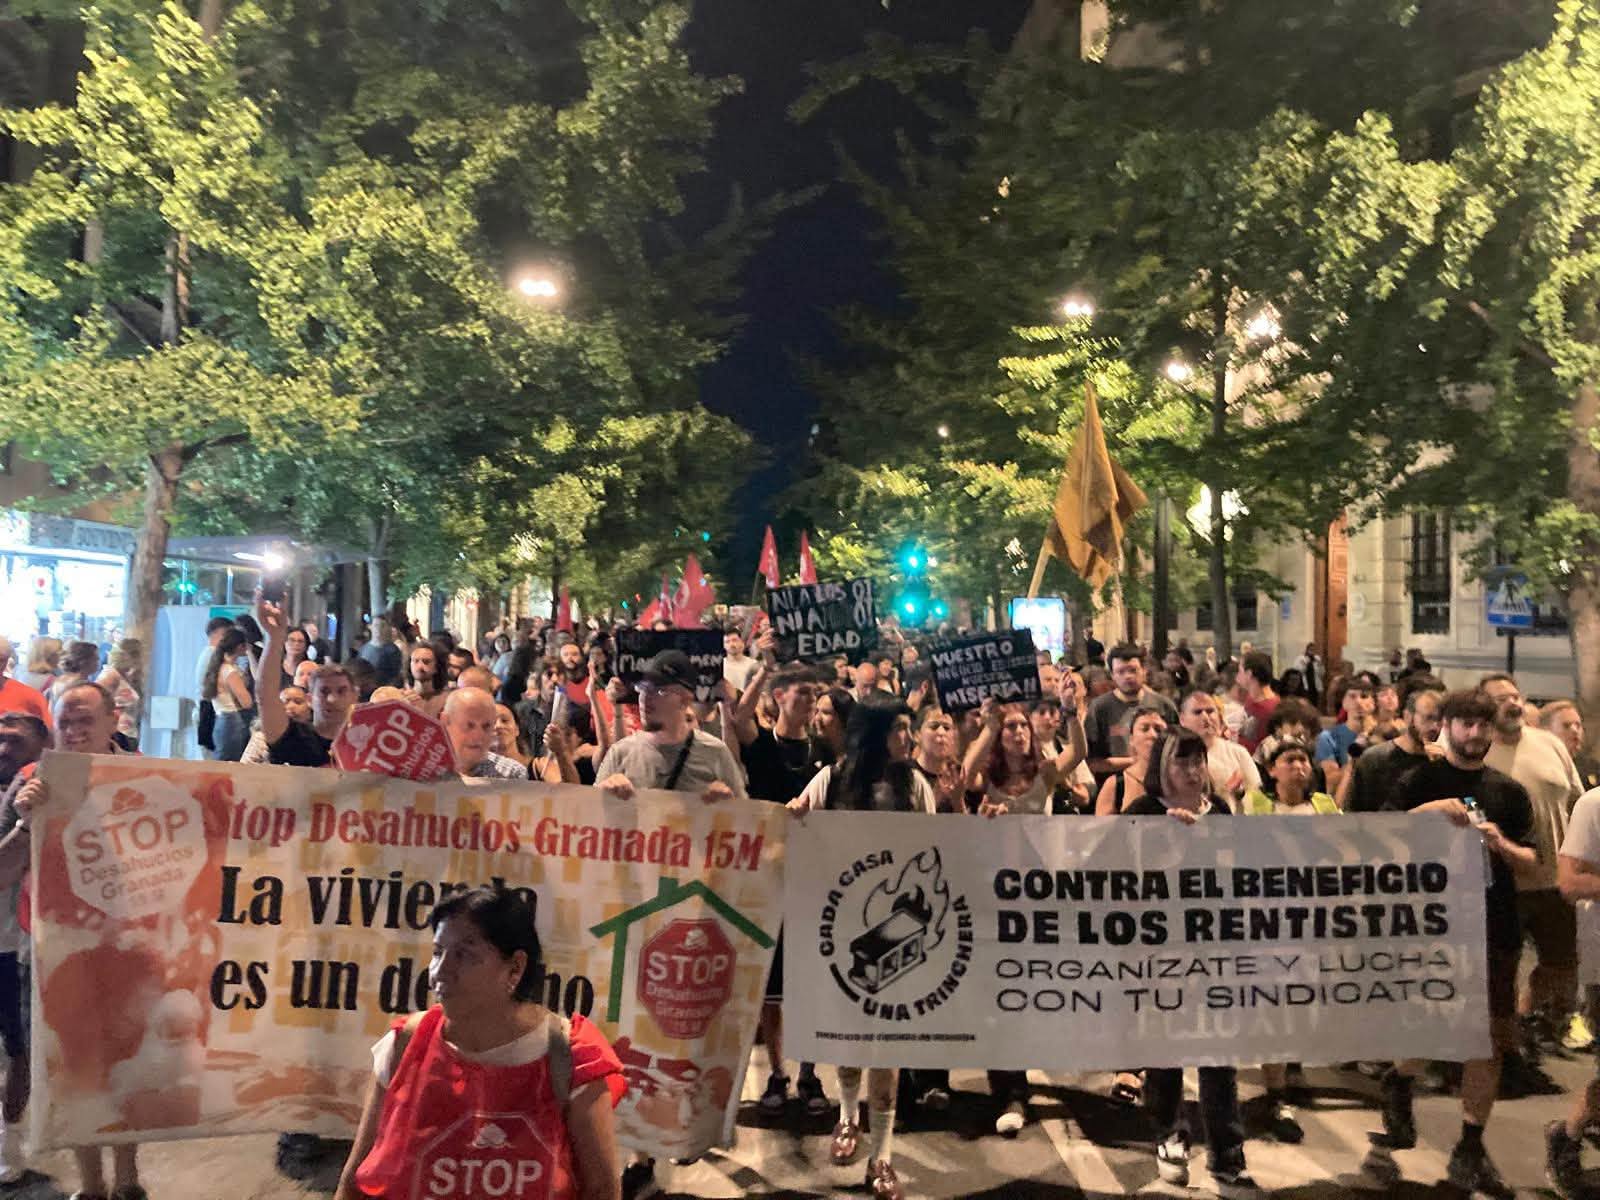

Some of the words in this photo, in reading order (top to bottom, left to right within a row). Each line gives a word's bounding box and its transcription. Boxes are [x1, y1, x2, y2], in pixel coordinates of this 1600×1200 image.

[798, 630, 861, 656] EDAD
[931, 641, 1014, 667] VUESTRO
[364, 709, 415, 771] TOP
[75, 808, 190, 865] STOP
[201, 777, 296, 848] Stop
[308, 803, 521, 854] Desahucios
[534, 816, 693, 868] Granada
[703, 830, 765, 872] 15M
[79, 847, 194, 886] Desahucios
[101, 867, 184, 901] Granada
[993, 868, 1170, 901] CONTRA
[1178, 868, 1224, 899] EL
[1231, 861, 1449, 898] BENEFICIO
[216, 866, 285, 926] La
[818, 889, 845, 958] CADA
[838, 850, 895, 888] CASA
[997, 910, 1060, 945] DE
[1077, 910, 1169, 946] LOS
[1184, 902, 1450, 943] RENTISTAS
[646, 951, 729, 985] STOP
[863, 997, 912, 1022] UNA
[913, 894, 974, 1017] TRINCHERA
[996, 954, 1258, 981] ORGANÍZATE
[1273, 954, 1300, 971] Y
[1319, 950, 1453, 973] LUCHA
[210, 959, 270, 1011] es
[290, 960, 361, 1011] un
[996, 988, 1102, 1013] CON
[1123, 988, 1184, 1012] TU
[1206, 978, 1456, 1010] SINDICATO
[429, 1157, 543, 1196] STOP
